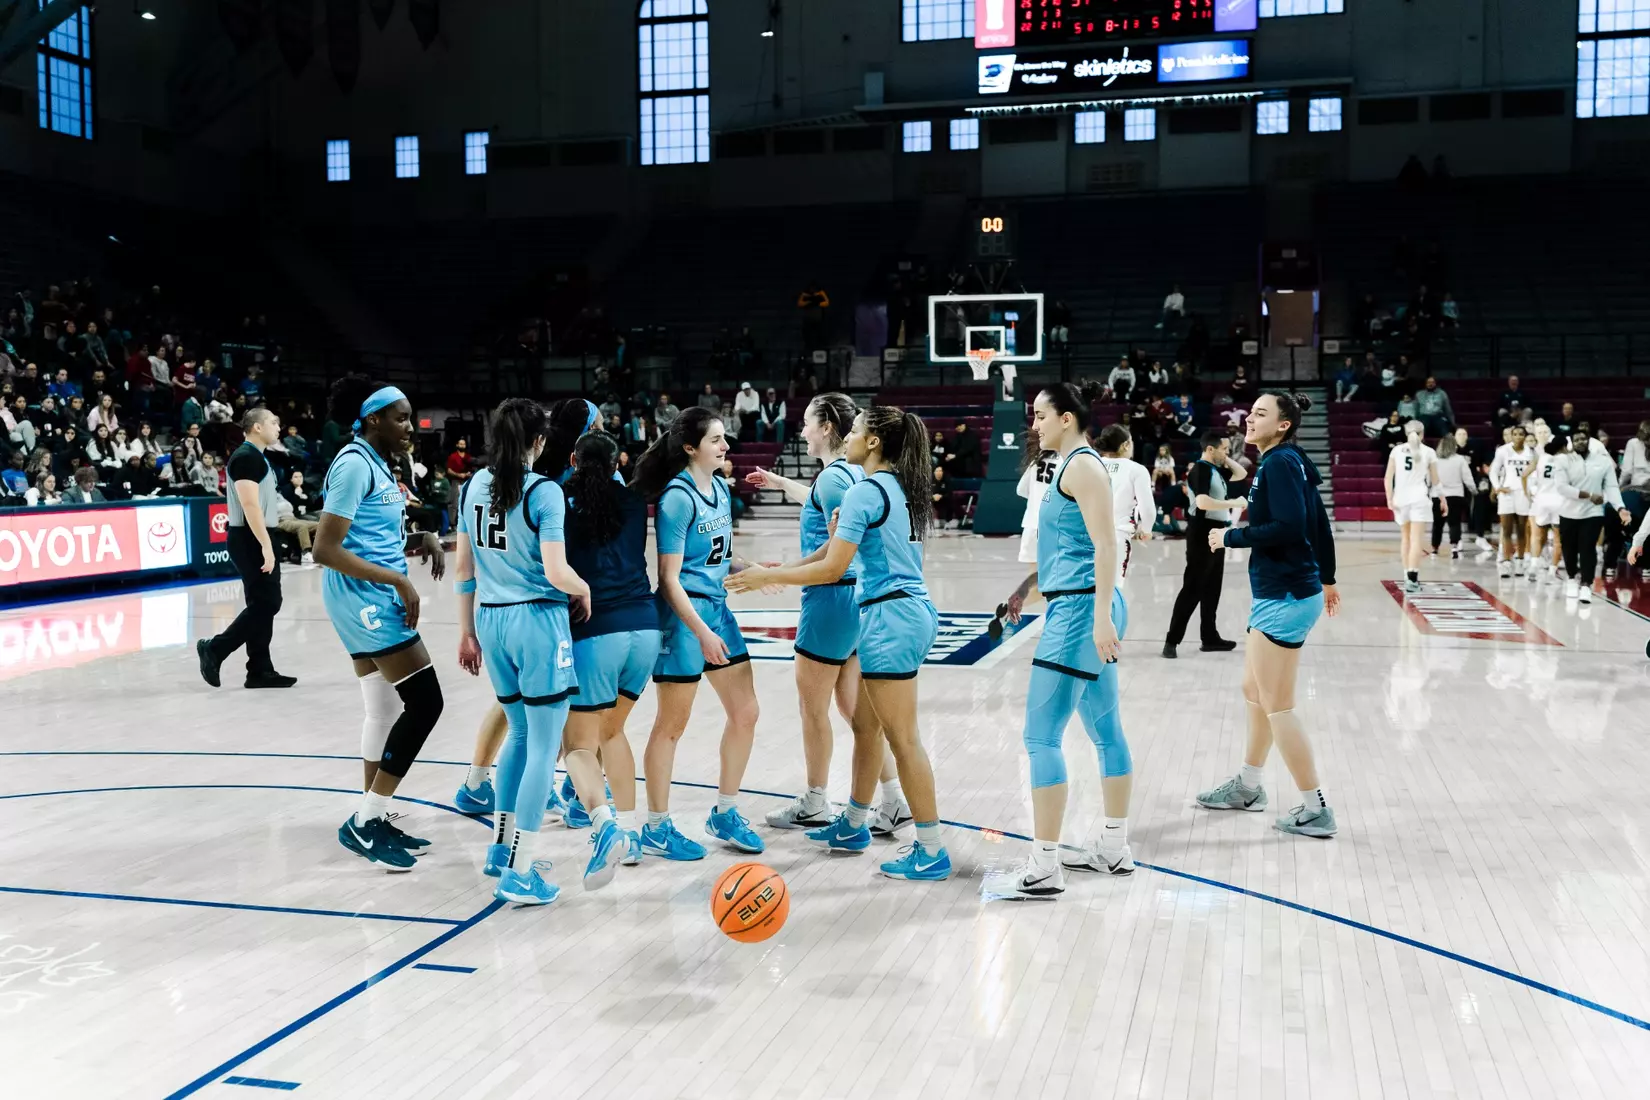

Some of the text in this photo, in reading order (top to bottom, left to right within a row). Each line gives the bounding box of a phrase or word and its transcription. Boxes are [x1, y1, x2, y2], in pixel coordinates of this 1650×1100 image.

[1035, 459, 1058, 485] 25
[1404, 456, 1413, 471] 5
[473, 503, 509, 552] 12
[0, 523, 123, 572] OYOTA
[204, 550, 230, 565] TOYO
[360, 604, 383, 631] C
[557, 640, 573, 670] C
[737, 885, 776, 922] ELITE
